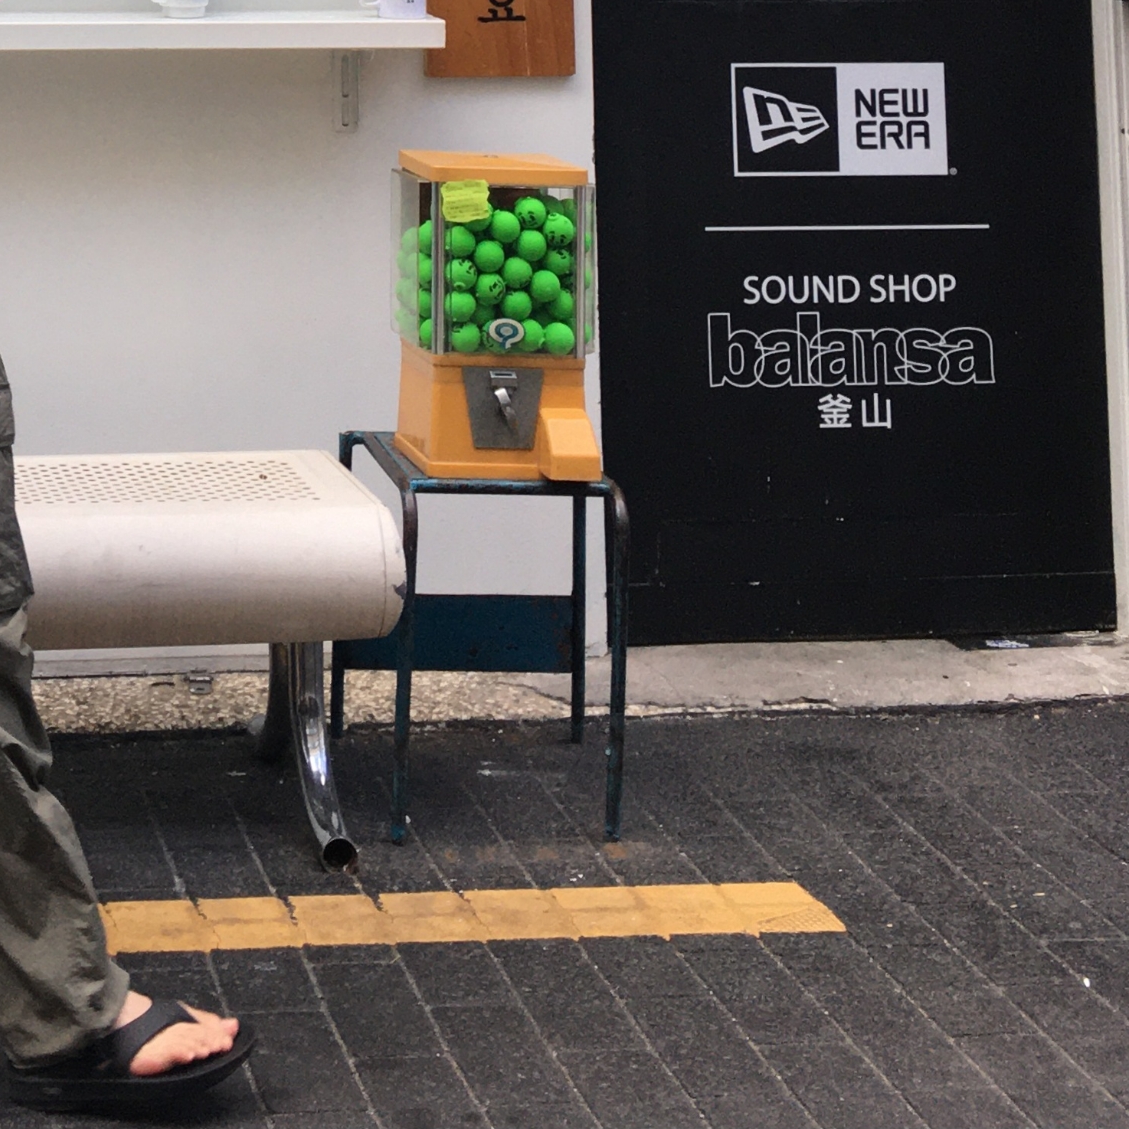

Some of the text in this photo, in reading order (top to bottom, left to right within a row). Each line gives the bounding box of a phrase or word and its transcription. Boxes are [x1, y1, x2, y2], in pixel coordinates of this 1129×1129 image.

[854, 88, 929, 117] NEW
[855, 120, 931, 150] ERA
[742, 273, 957, 305] SOUND SHOP
[707, 311, 996, 388] balansa
[817, 392, 892, 430] 釜山
